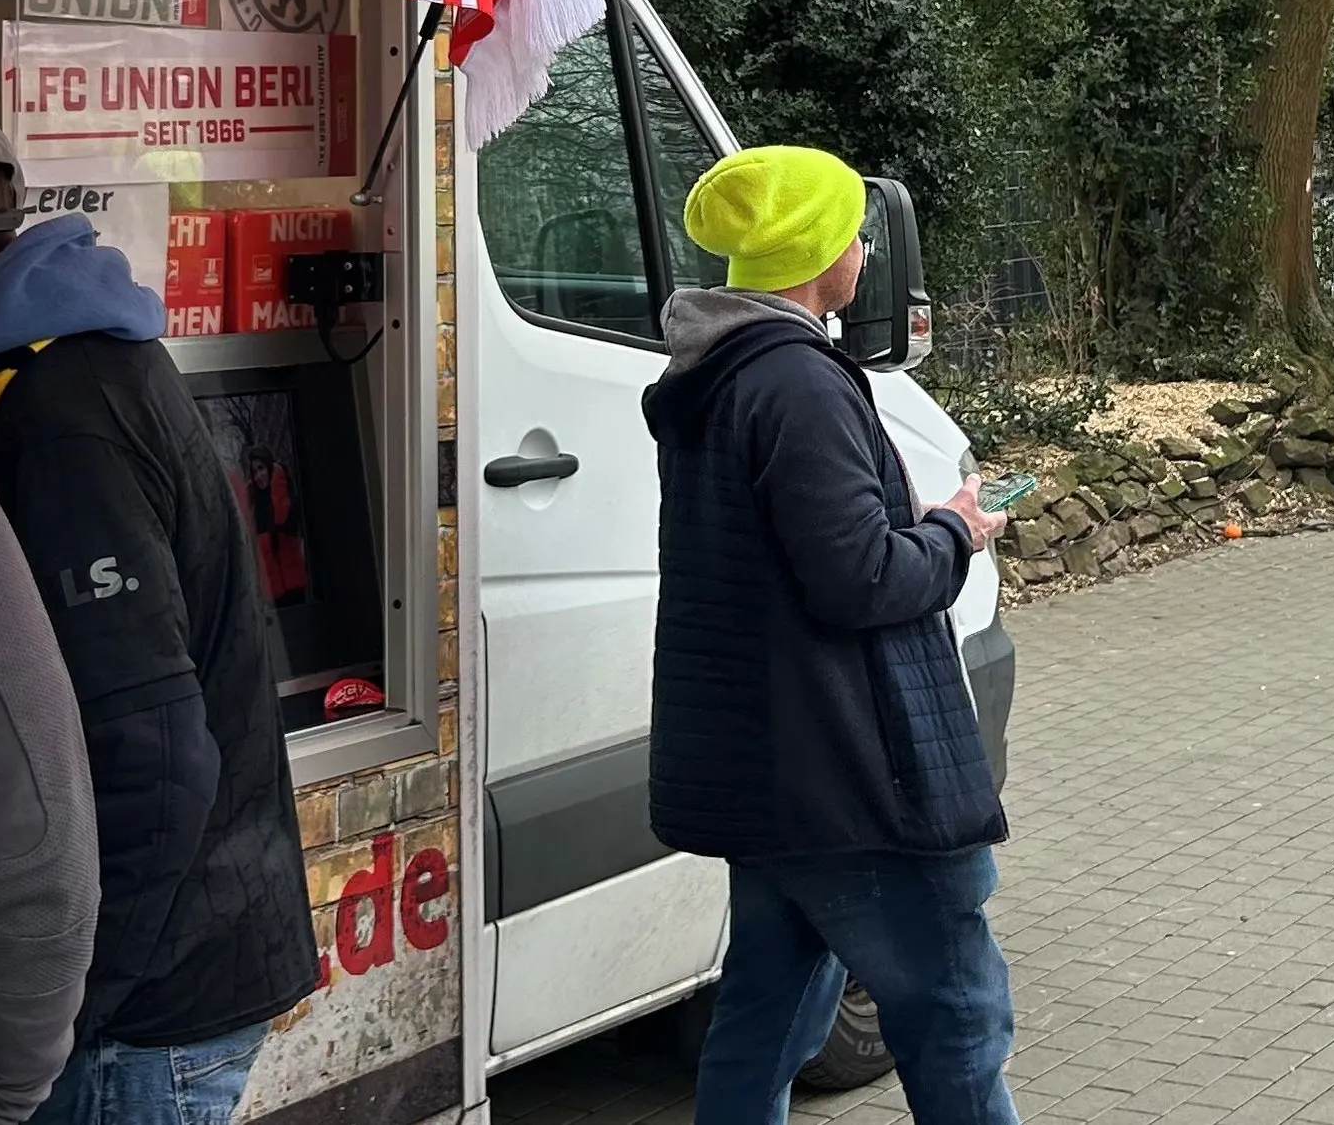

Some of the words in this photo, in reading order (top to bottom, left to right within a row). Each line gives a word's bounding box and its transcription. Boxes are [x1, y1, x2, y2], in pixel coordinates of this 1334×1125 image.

[100, 65, 223, 112] UNION
[143, 120, 192, 147] SEIT
[197, 118, 246, 146] 1966
[269, 212, 338, 244] NICHT
